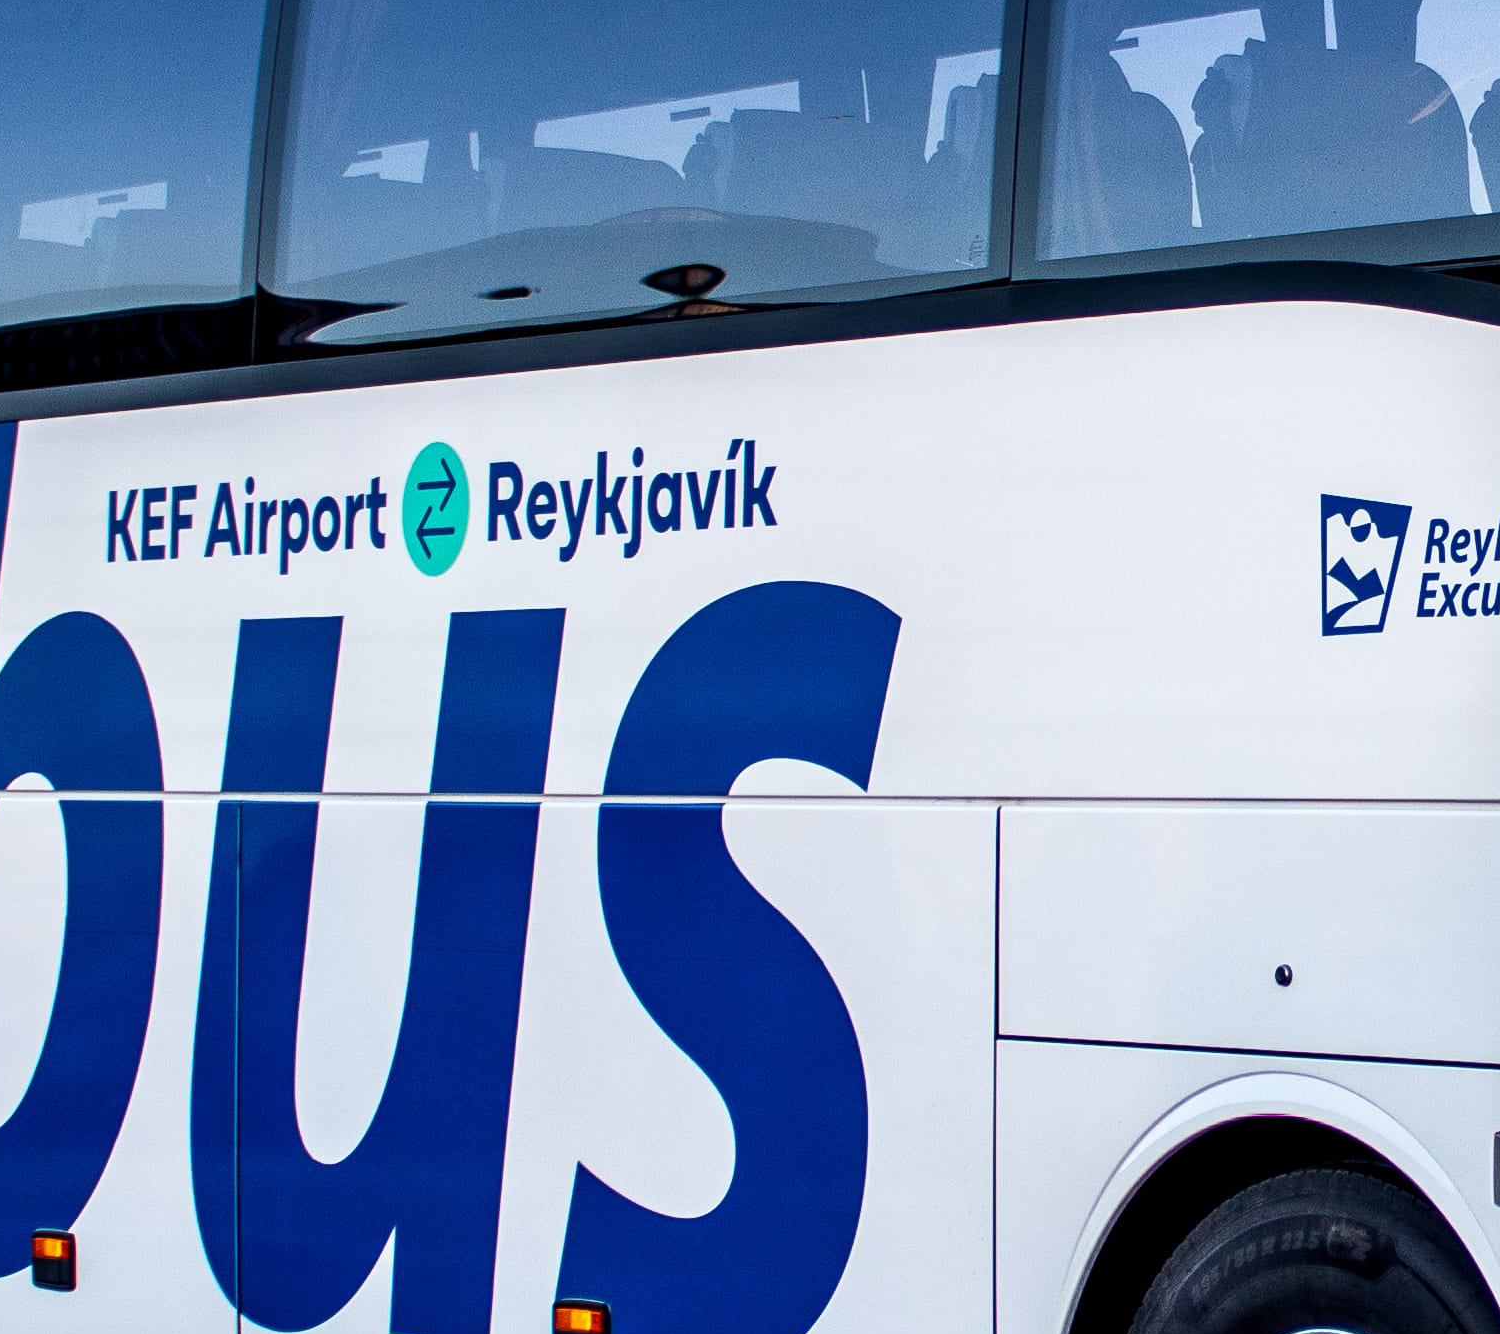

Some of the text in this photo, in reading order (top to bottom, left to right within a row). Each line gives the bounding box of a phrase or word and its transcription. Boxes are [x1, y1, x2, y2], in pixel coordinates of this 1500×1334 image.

[107, 439, 777, 575] KEF Airport Reykjavík
